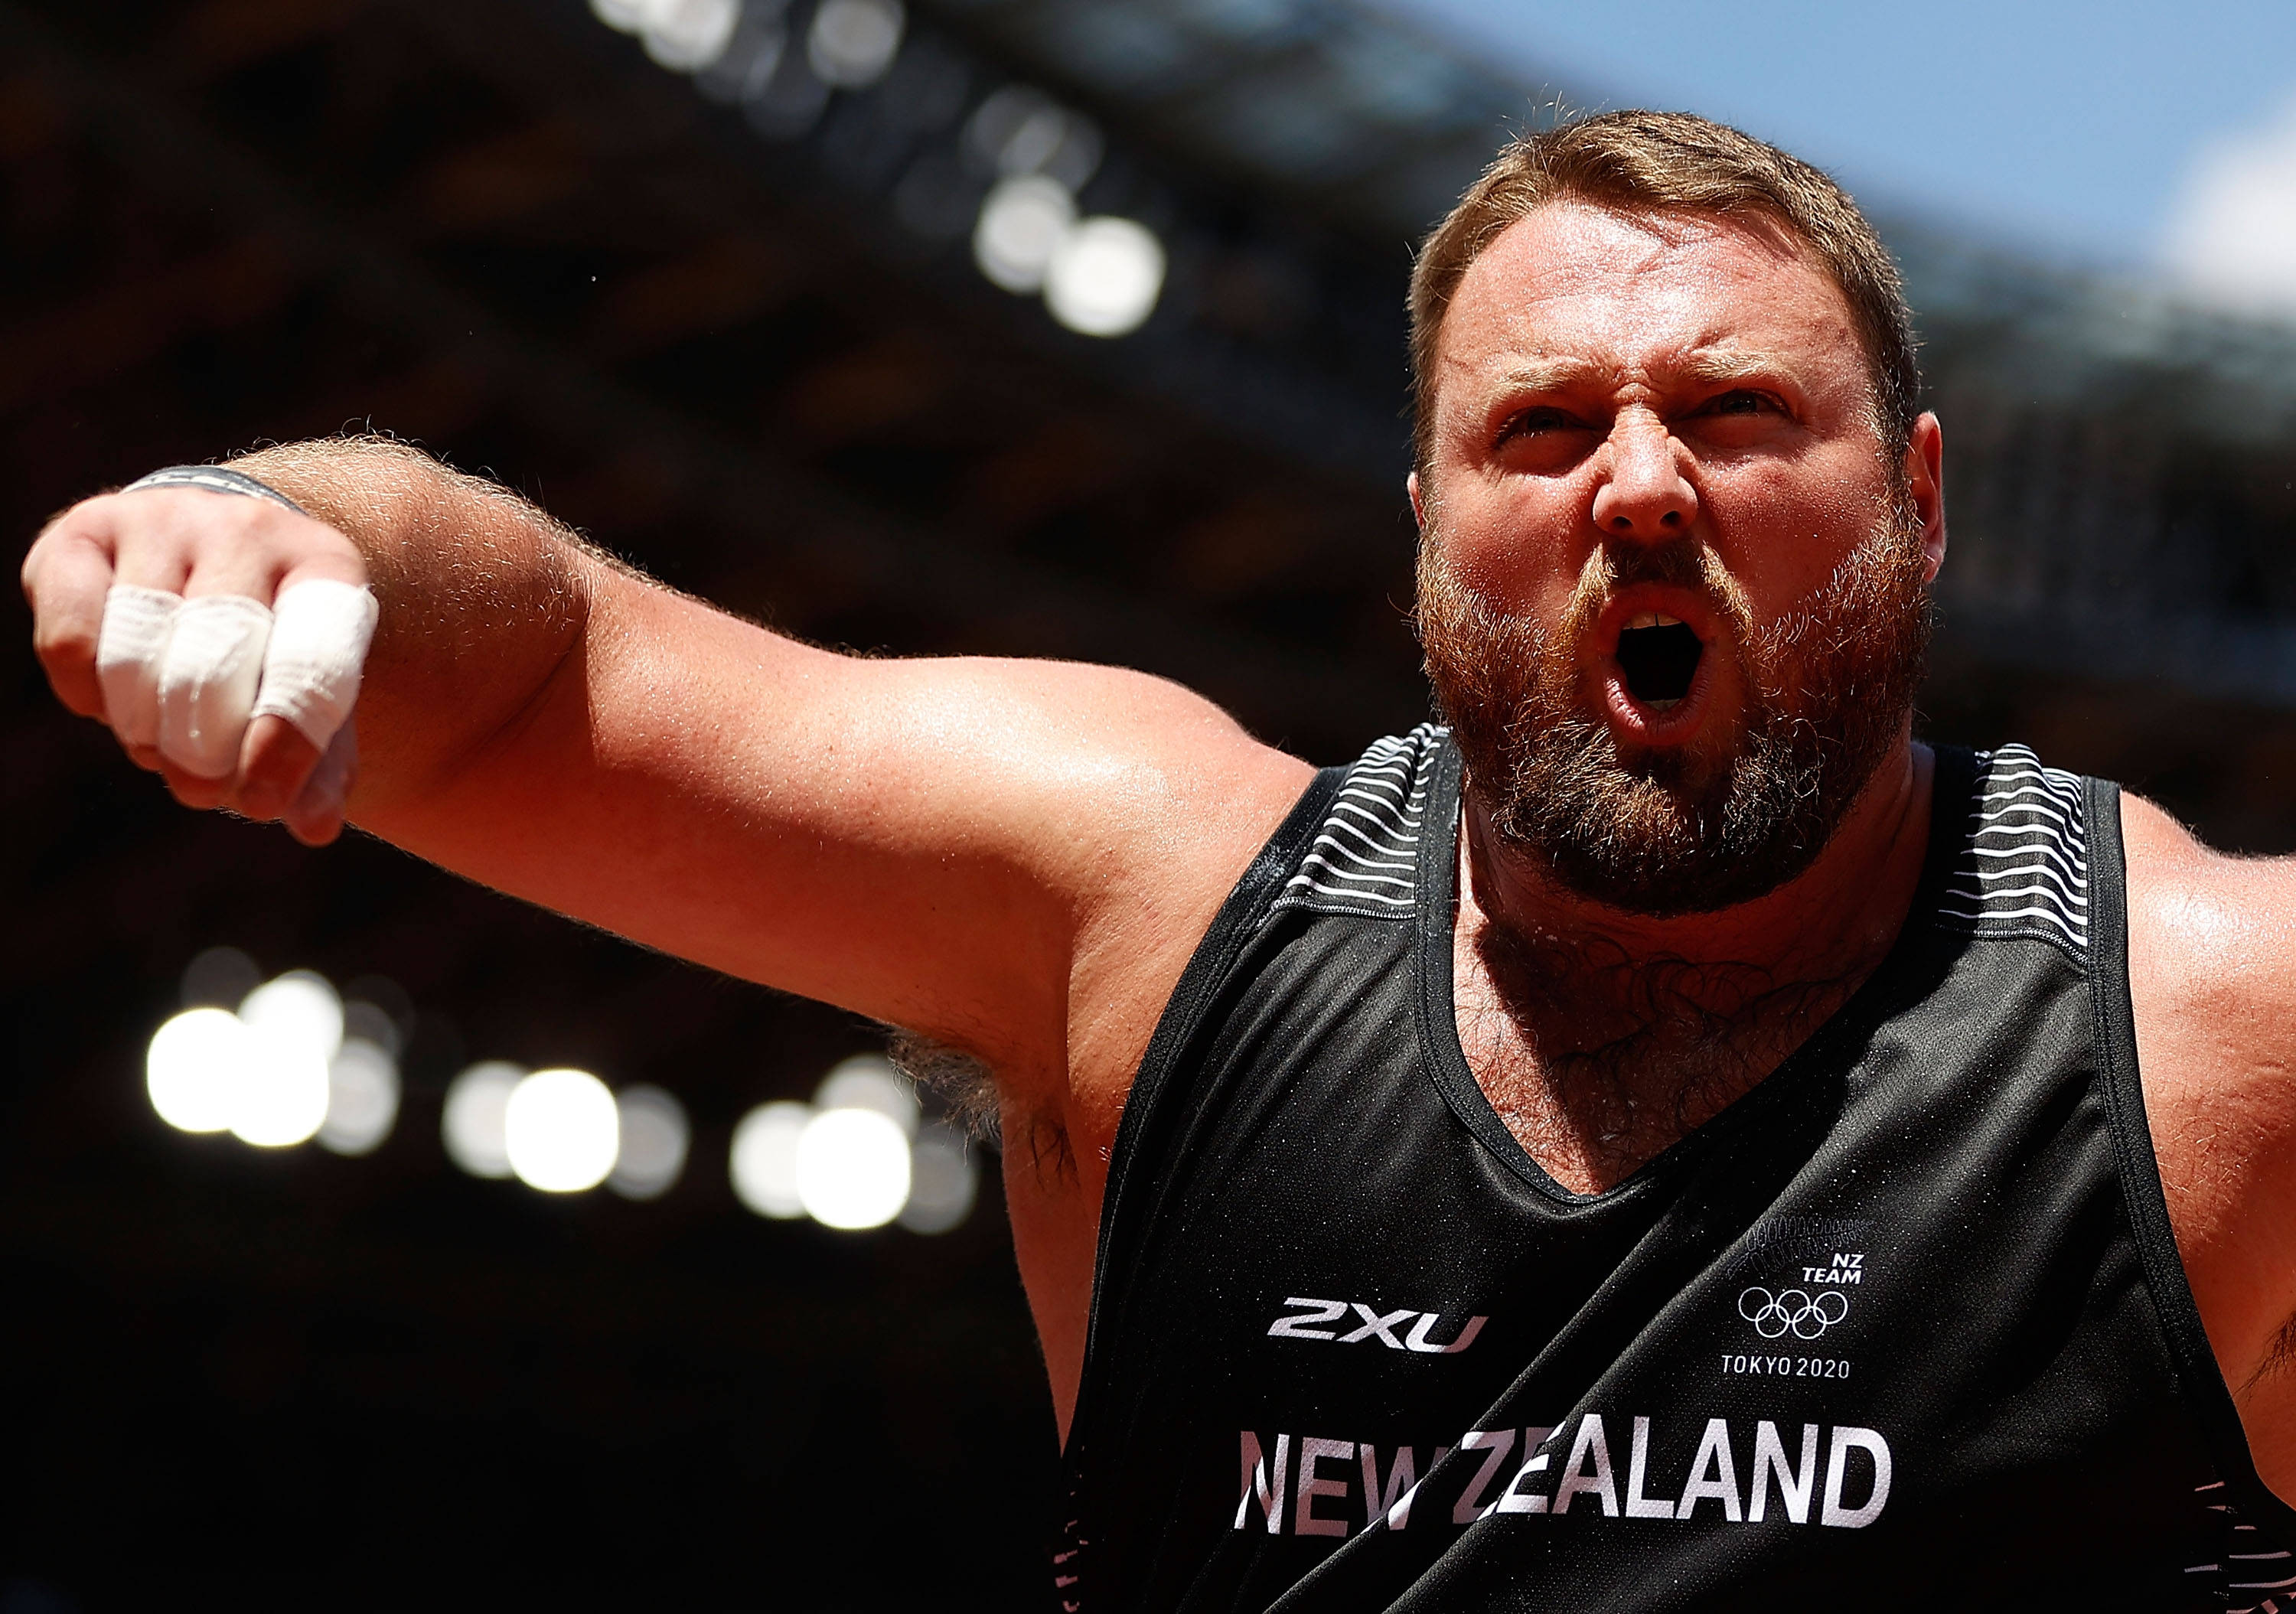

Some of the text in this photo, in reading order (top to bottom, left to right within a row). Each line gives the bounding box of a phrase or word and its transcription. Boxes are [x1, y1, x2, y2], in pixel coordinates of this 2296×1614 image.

[1832, 1253, 1864, 1268] NZ
[1802, 1267, 1861, 1284] TEAM
[1267, 1296, 1489, 1354] 2XU
[1722, 1355, 1850, 1378] TOKYO 2020
[1234, 1412, 1893, 1537] NEW ZEALAND
